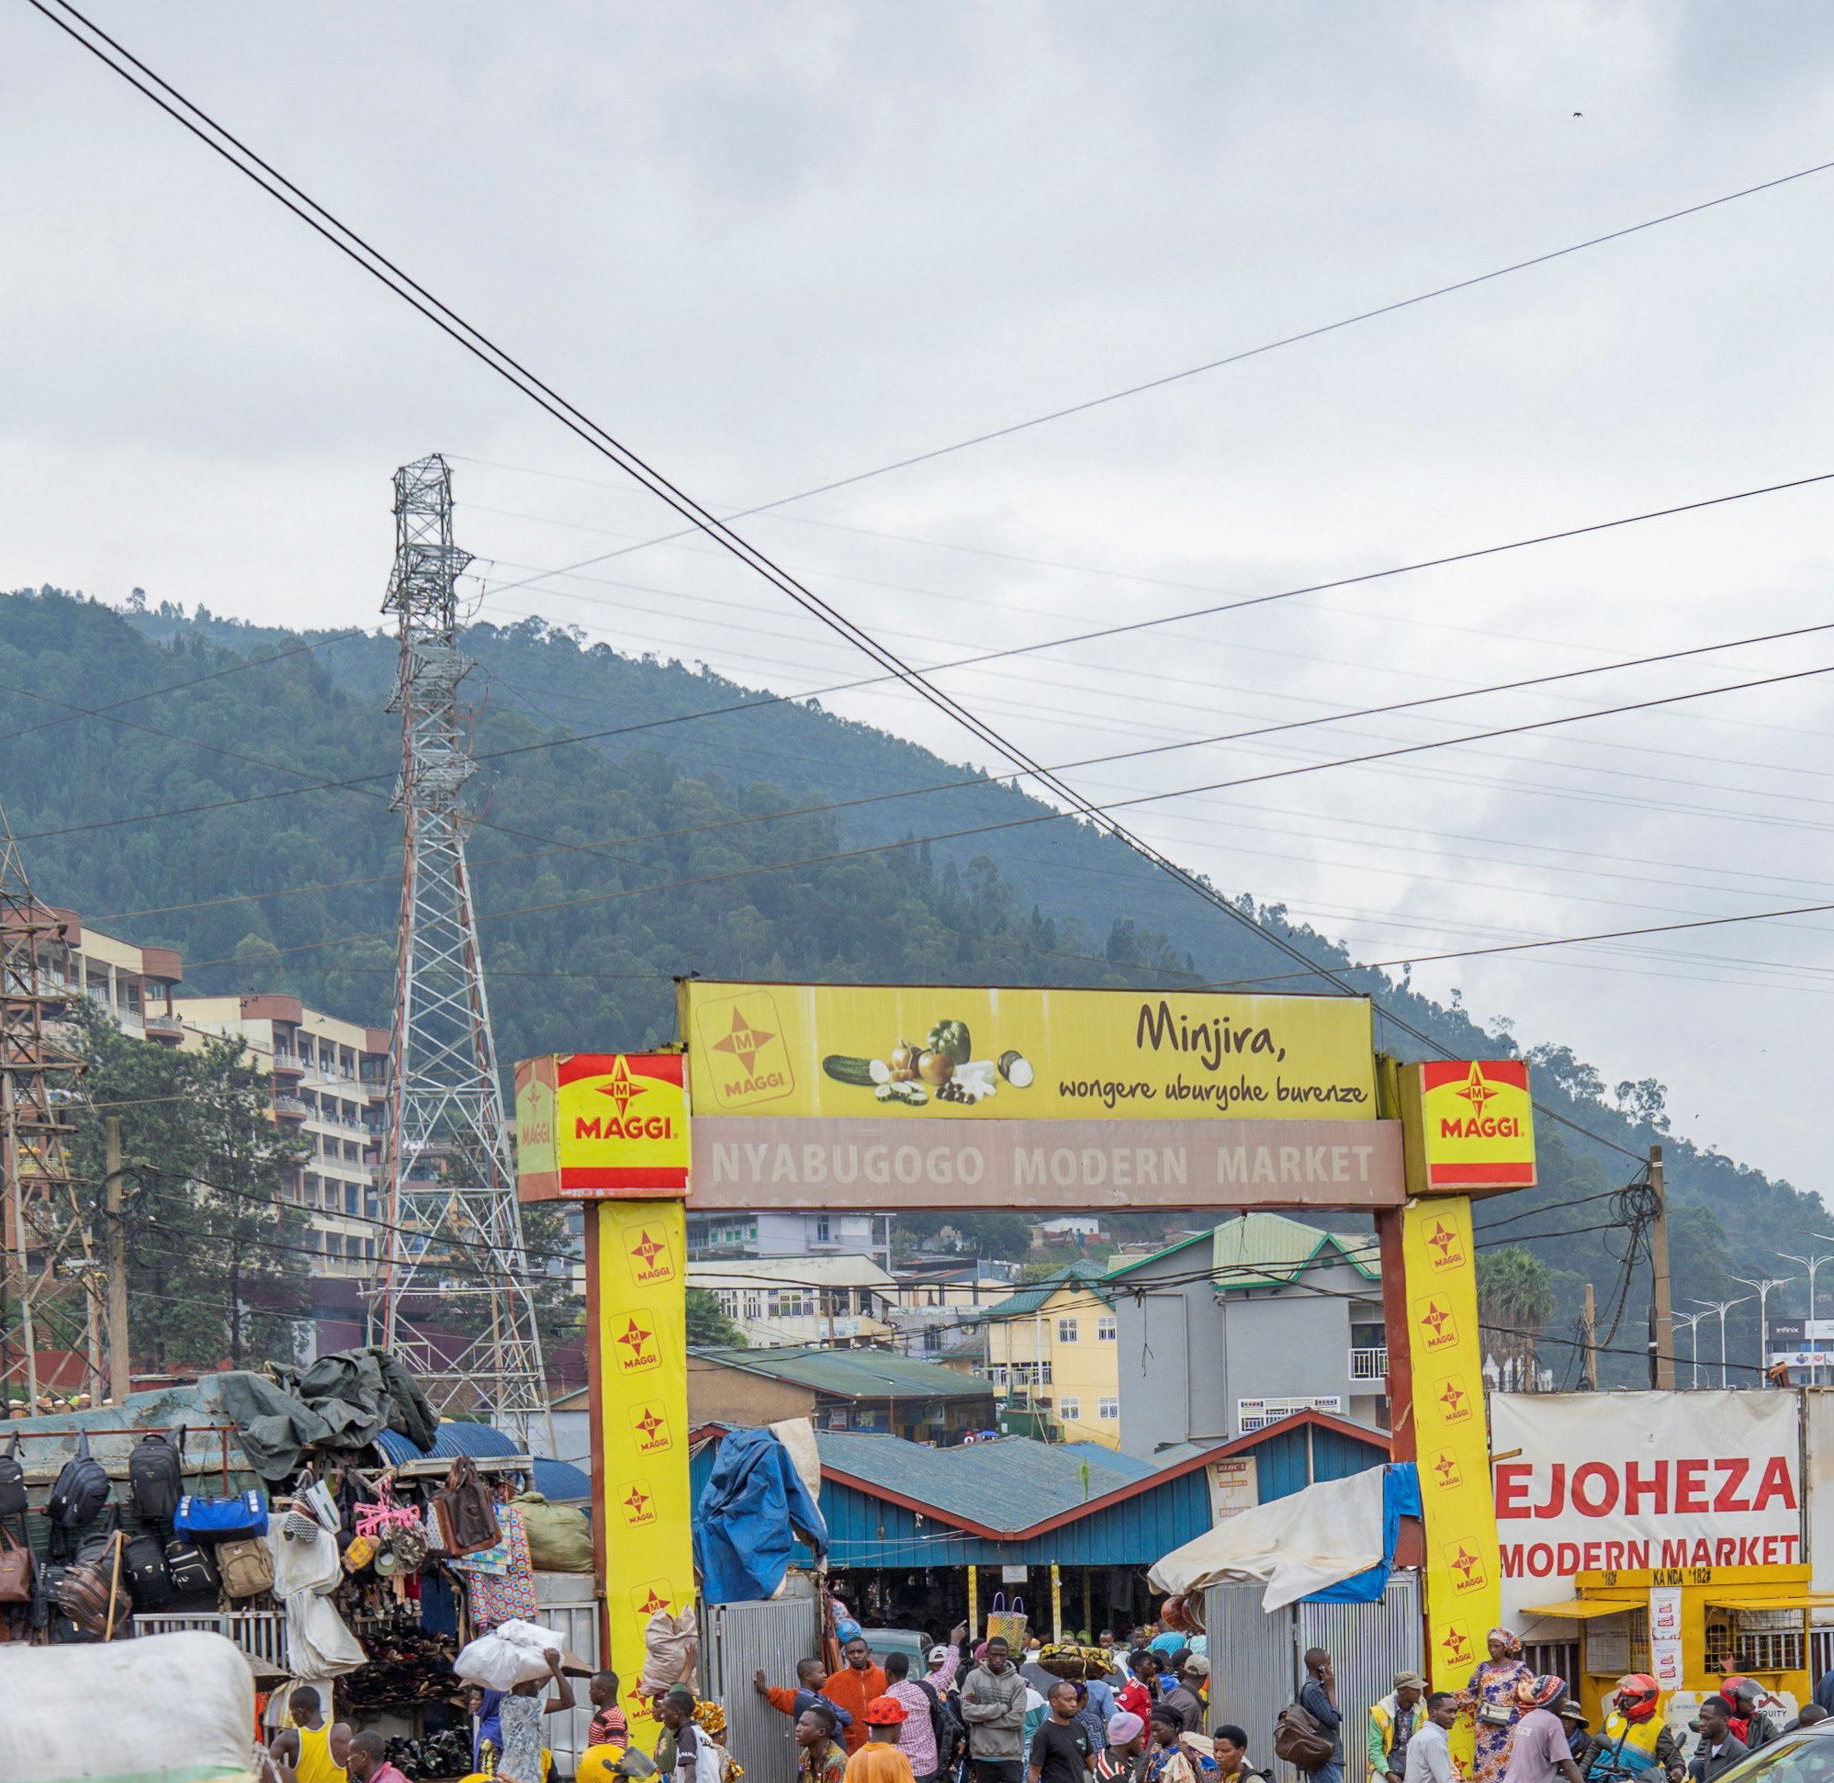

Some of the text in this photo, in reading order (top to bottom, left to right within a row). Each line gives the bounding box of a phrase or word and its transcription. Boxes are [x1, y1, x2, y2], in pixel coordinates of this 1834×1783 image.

[1135, 1000, 1286, 1071] Minjira,
[724, 1072, 785, 1098] MAGGI
[1059, 1074, 1368, 1111] wongere uburyohe burenze
[574, 1115, 672, 1140] MAGGI
[1440, 1116, 1519, 1139] MAGGI
[711, 1142, 1374, 1186] NYABUGOGO MODERN MARKET
[1434, 1253, 1463, 1268] MAGGI
[637, 1265, 671, 1282] MAGGI
[1427, 1332, 1456, 1348] MAGGI
[623, 1353, 658, 1370] MAGGI
[1494, 1456, 1798, 1520] EJOHEZA
[1499, 1534, 1799, 1579] MODERN MARKET
[1456, 1575, 1484, 1591] MAGGI
[631, 1707, 654, 1720] MAG
